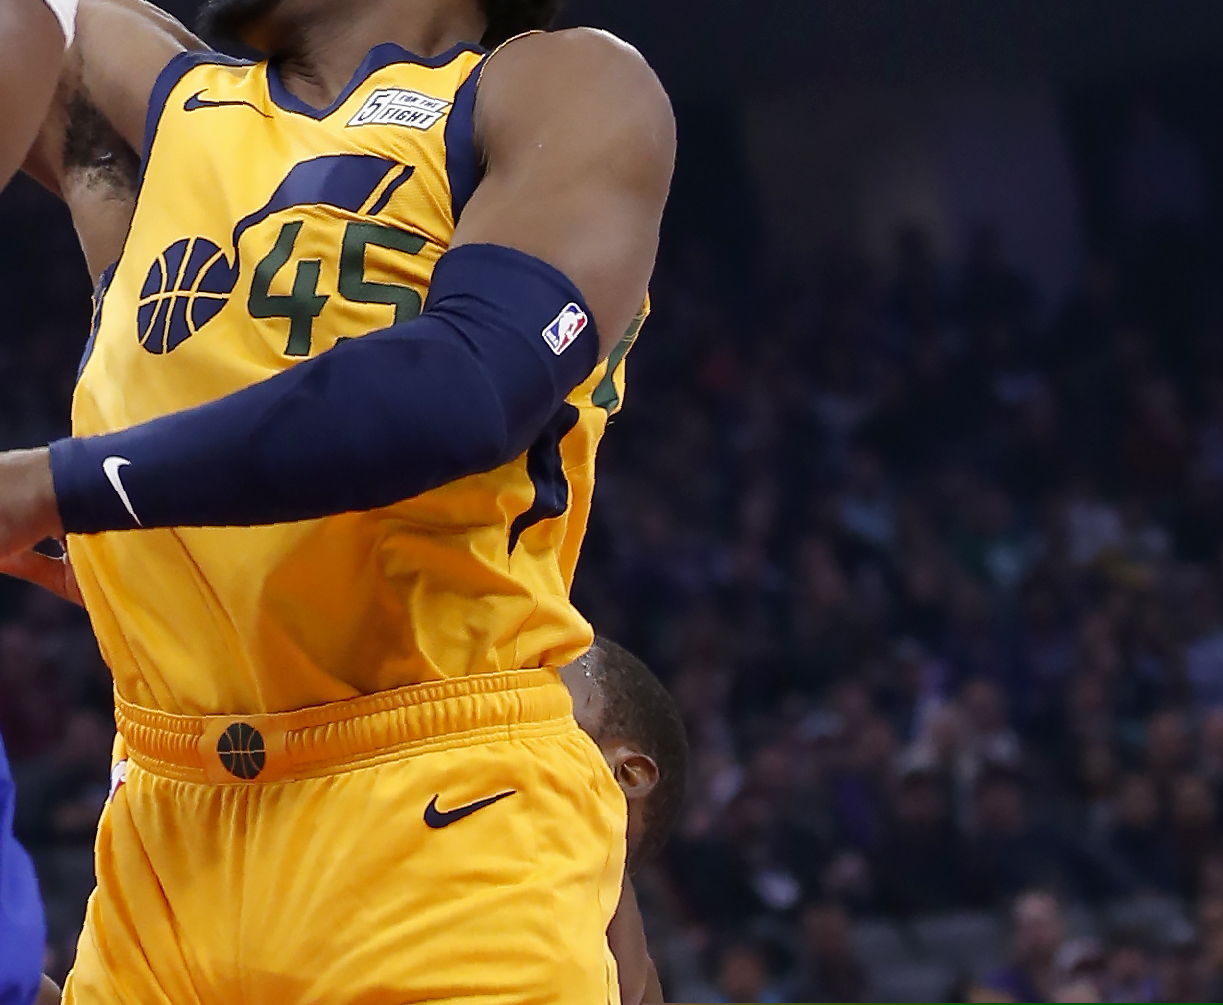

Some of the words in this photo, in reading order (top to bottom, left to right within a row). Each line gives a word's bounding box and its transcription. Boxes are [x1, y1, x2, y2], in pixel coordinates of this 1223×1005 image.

[357, 93, 392, 122] 5
[379, 107, 435, 125] FIGHT
[247, 220, 426, 356] 45
